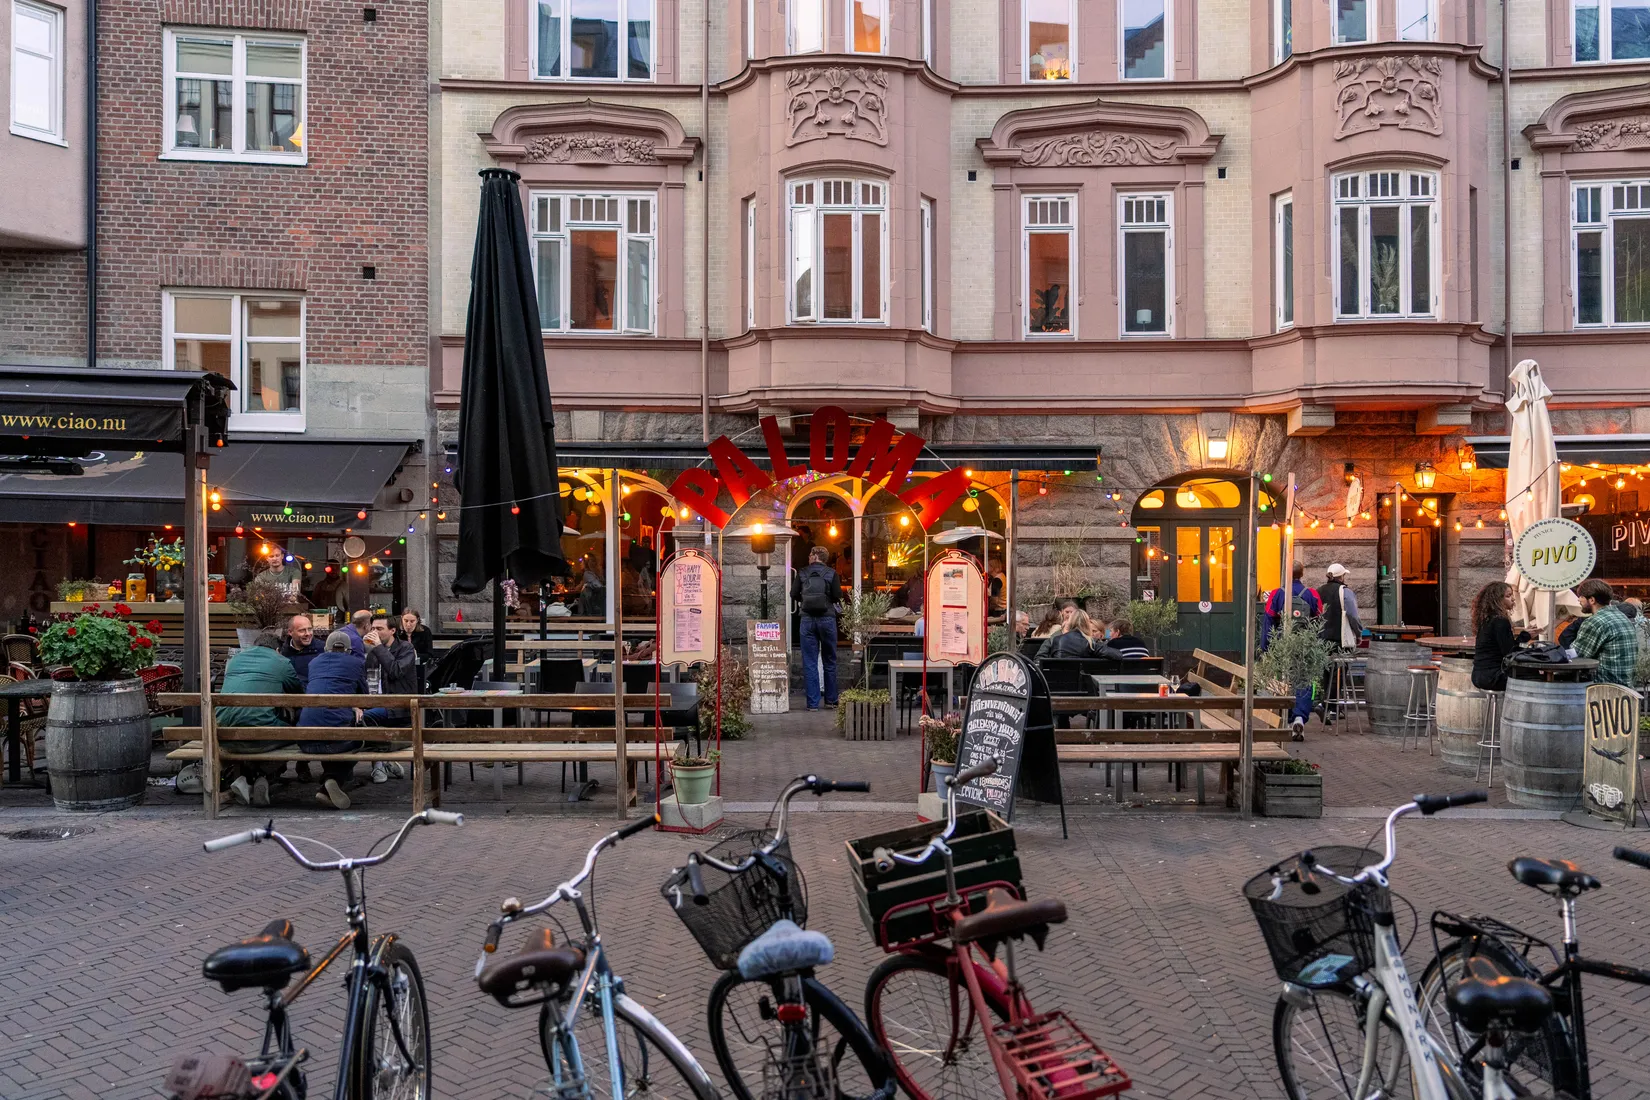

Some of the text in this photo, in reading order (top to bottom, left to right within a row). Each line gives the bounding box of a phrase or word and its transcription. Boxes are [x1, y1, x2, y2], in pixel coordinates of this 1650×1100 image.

[1, 412, 127, 430] www.ciao.nu
[667, 405, 972, 530] PALOMA
[251, 511, 335, 524] www.ciao.nu
[1531, 543, 1577, 567] PIVO
[1588, 695, 1633, 740] PIVO
[1397, 972, 1433, 1062] MONARK
